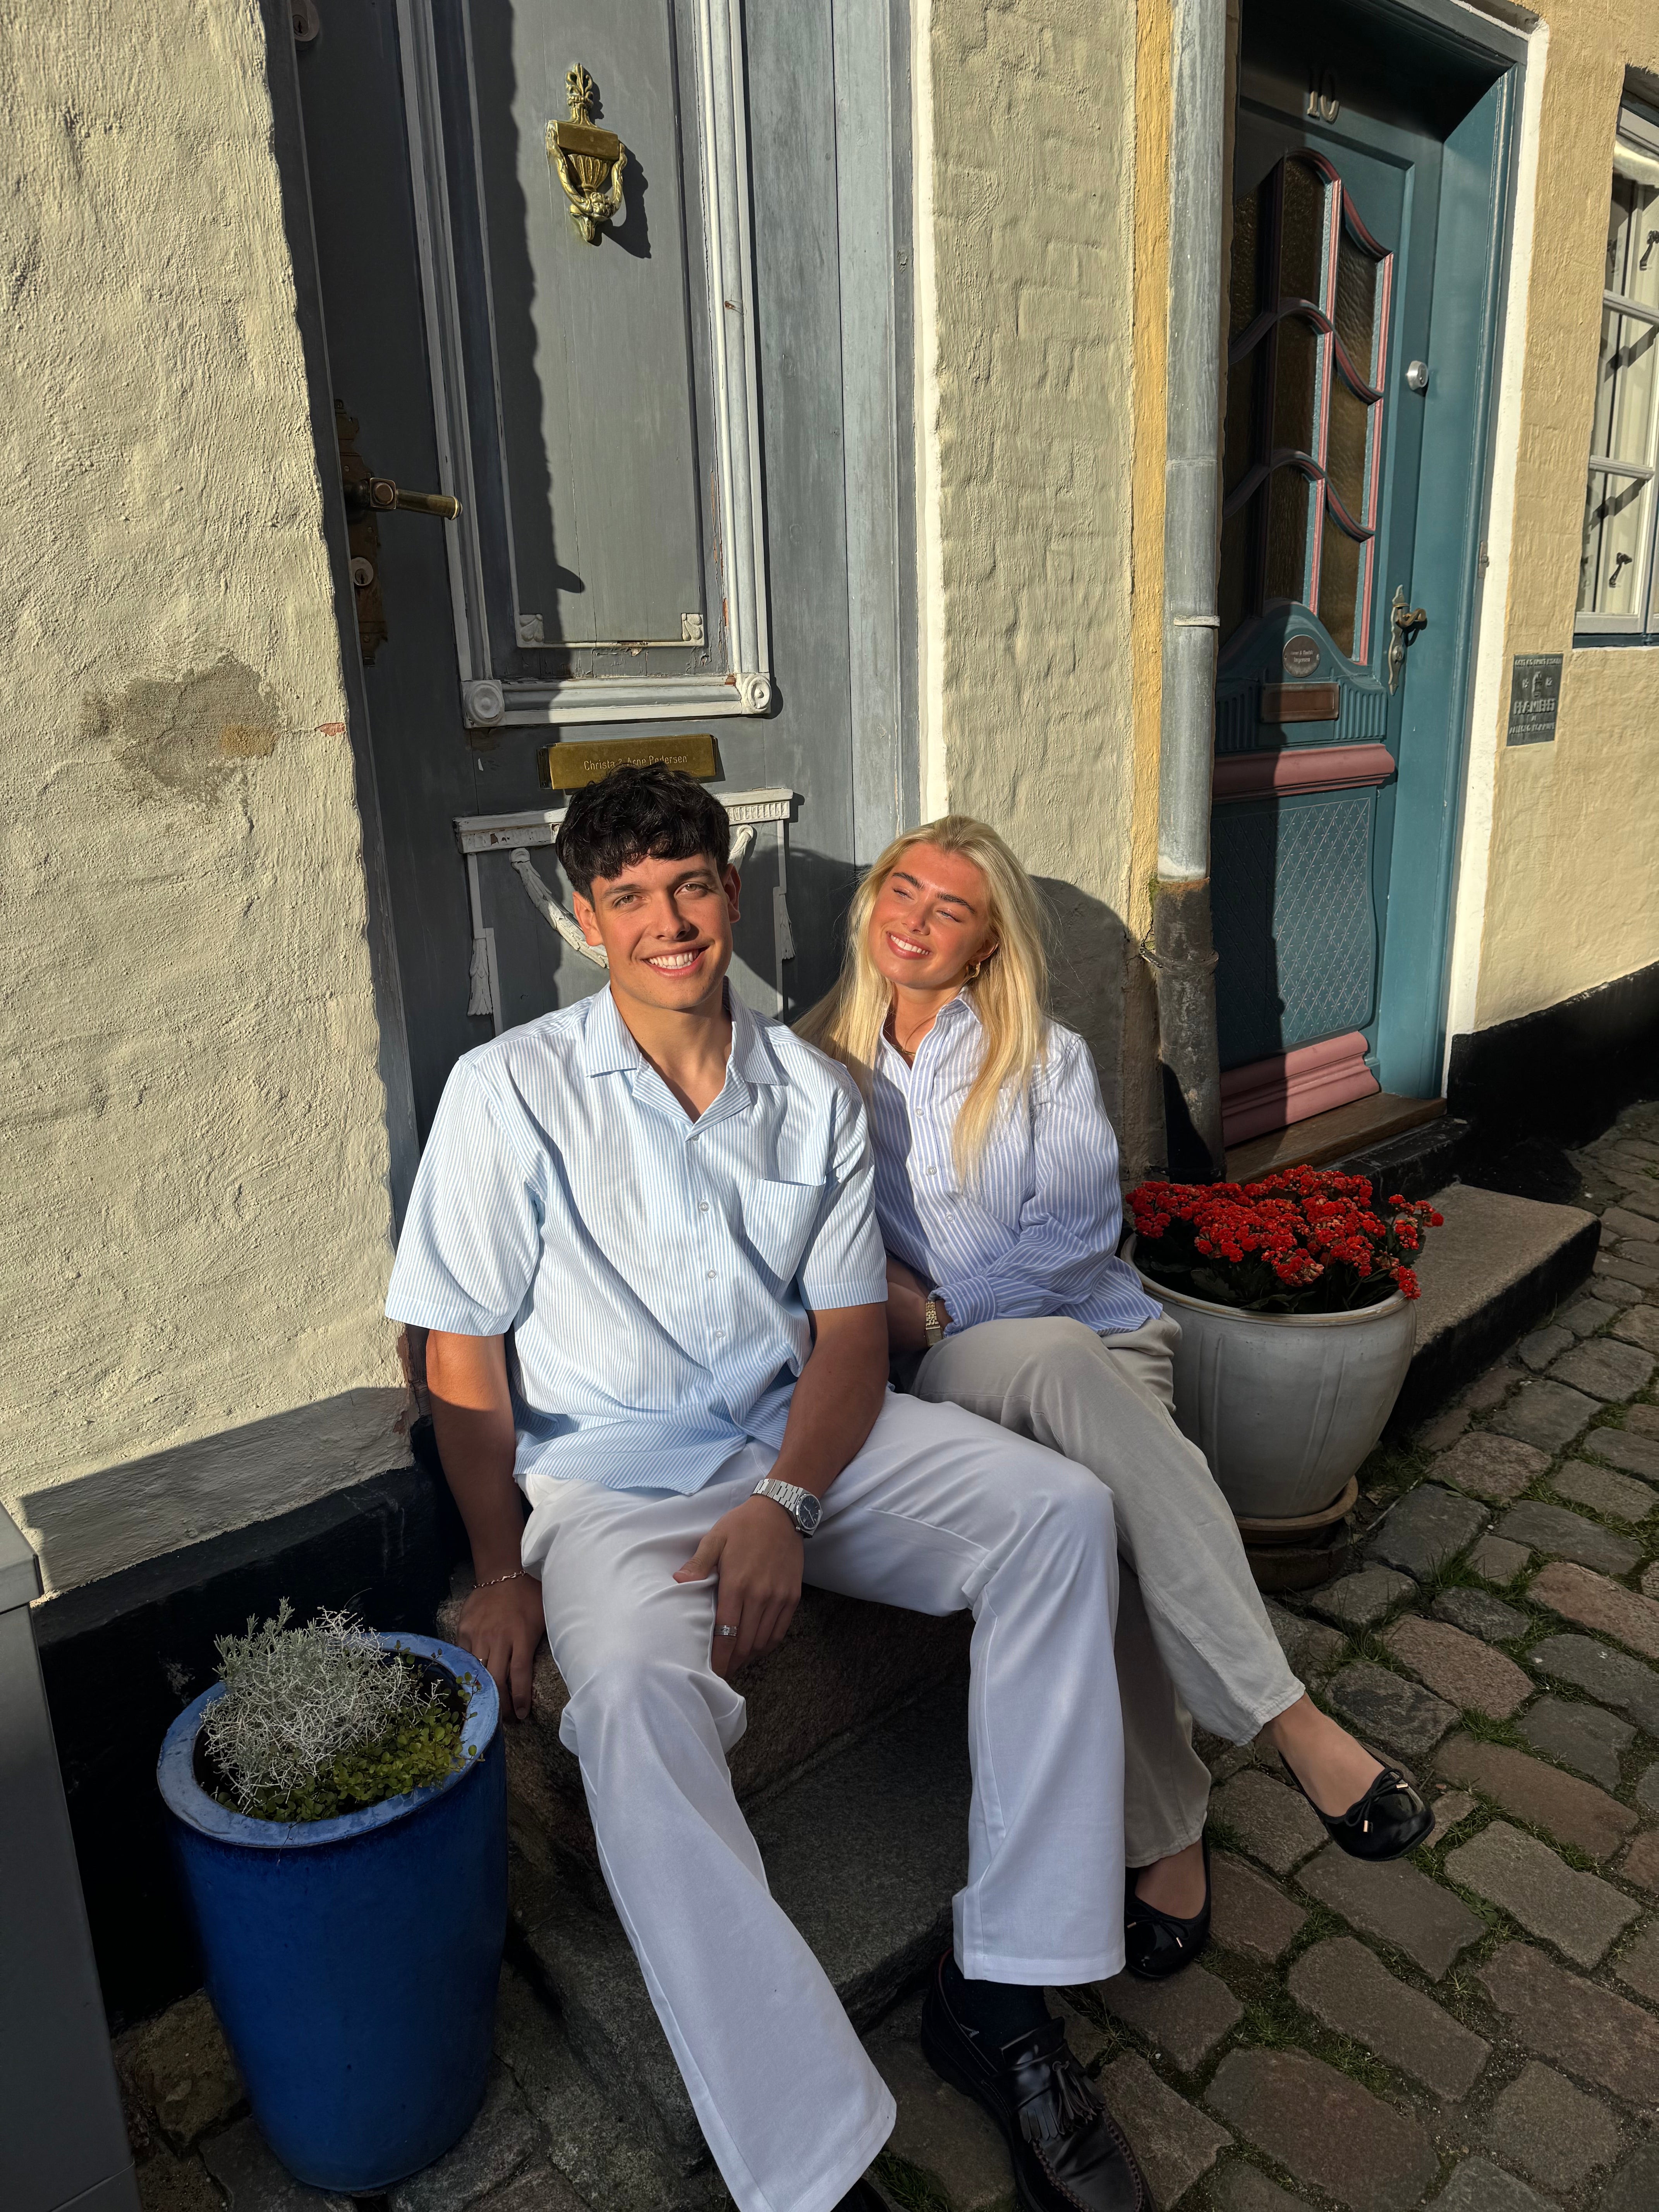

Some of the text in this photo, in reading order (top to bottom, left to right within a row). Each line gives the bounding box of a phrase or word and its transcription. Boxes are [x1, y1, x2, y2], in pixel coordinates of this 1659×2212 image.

[1307, 71, 1340, 122] 10
[584, 759, 615, 771] Christa
[627, 757, 646, 766] Arne
[649, 754, 687, 765] Pedersen
